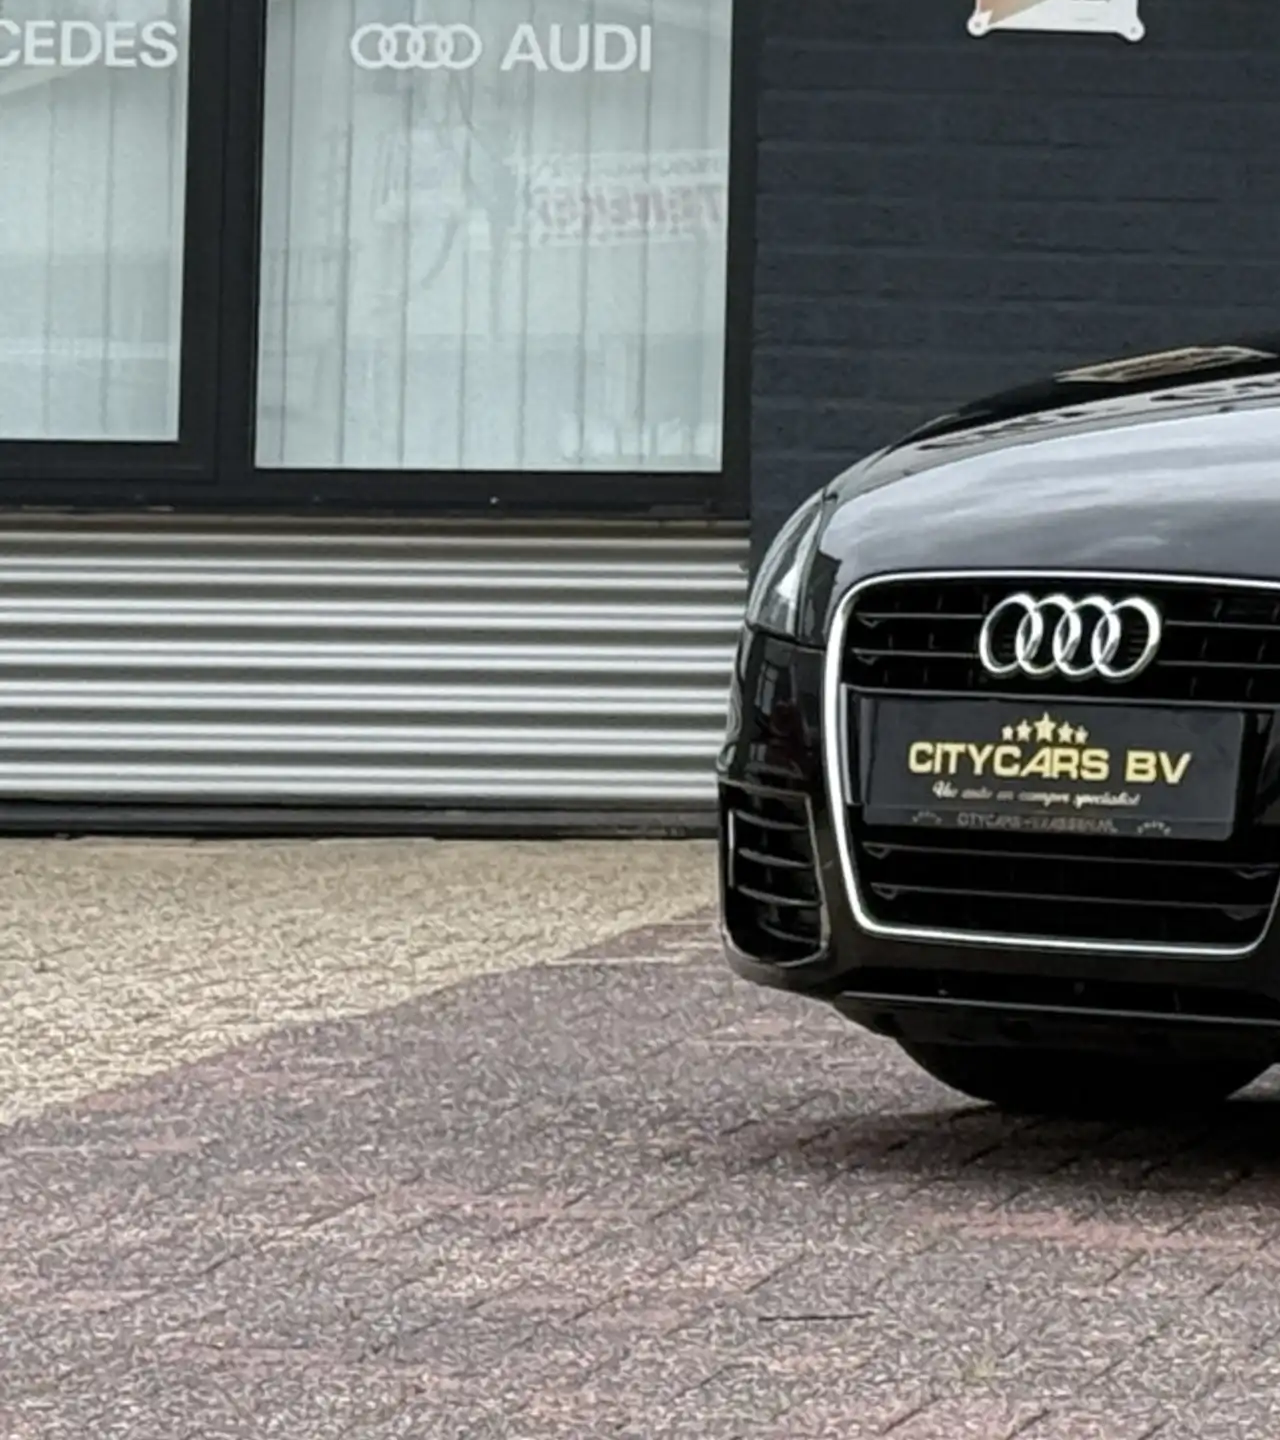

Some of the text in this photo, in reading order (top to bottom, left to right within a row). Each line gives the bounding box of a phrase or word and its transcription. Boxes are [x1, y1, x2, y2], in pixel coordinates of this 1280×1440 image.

[501, 23, 652, 72] AUDI
[908, 741, 1192, 785] CITYCARS BV
